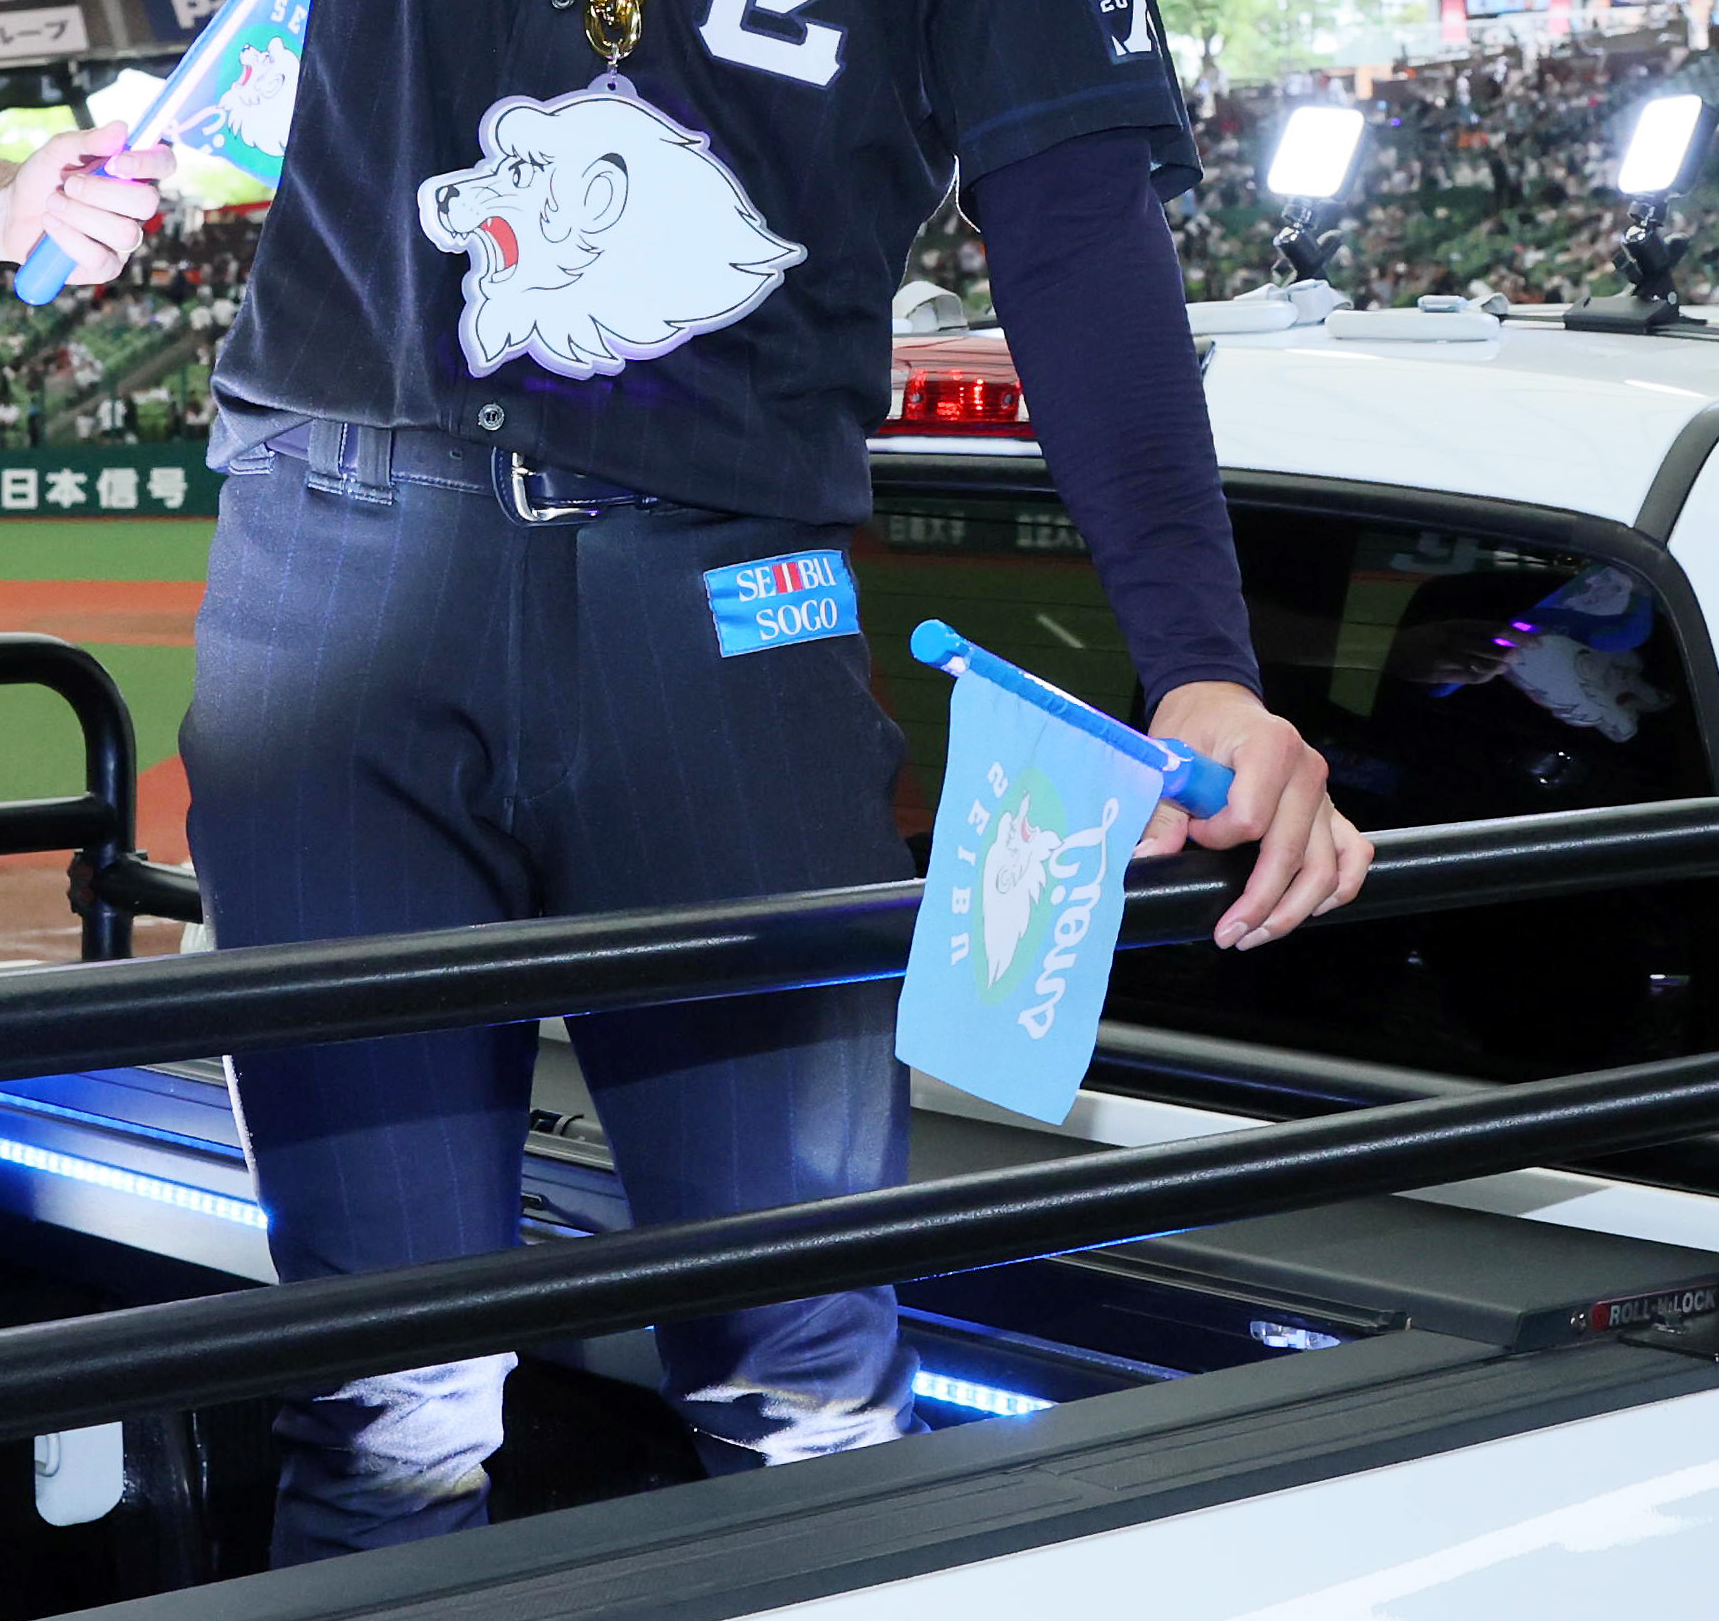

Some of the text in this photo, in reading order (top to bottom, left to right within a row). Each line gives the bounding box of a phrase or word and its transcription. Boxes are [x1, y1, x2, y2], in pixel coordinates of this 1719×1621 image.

[0, 465, 189, 511] 日本信号
[735, 556, 837, 602] SEIBU
[755, 597, 838, 641] SOGO
